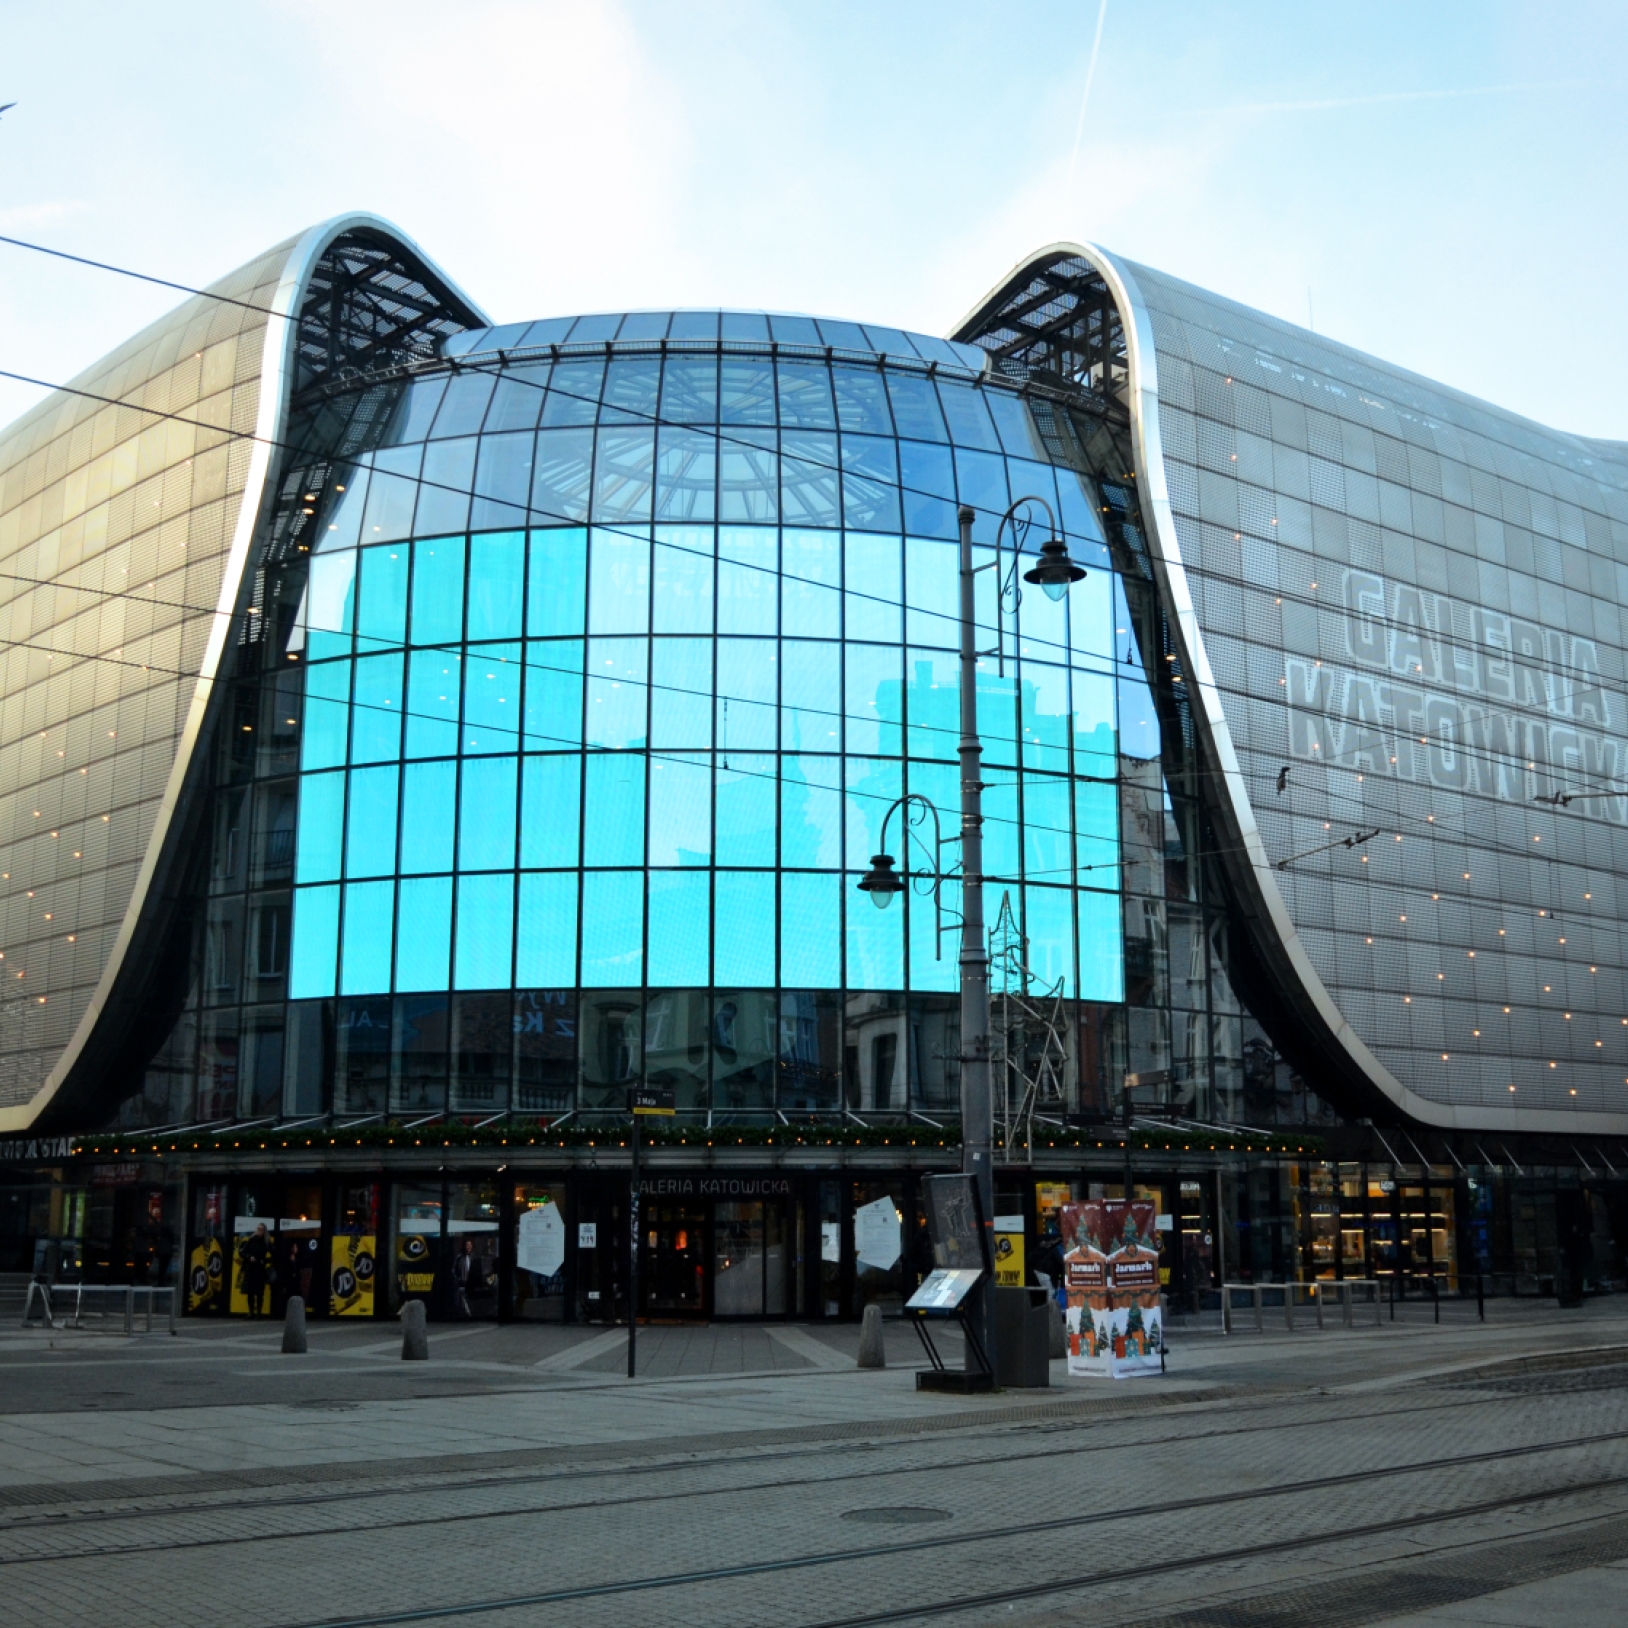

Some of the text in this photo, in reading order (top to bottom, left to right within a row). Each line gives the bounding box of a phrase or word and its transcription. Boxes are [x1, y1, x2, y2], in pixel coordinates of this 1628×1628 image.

[1342, 568, 1611, 727] GALERIA
[1286, 658, 1628, 825] KATOWICK
[630, 1178, 790, 1195] ALERIA KATOWICKA
